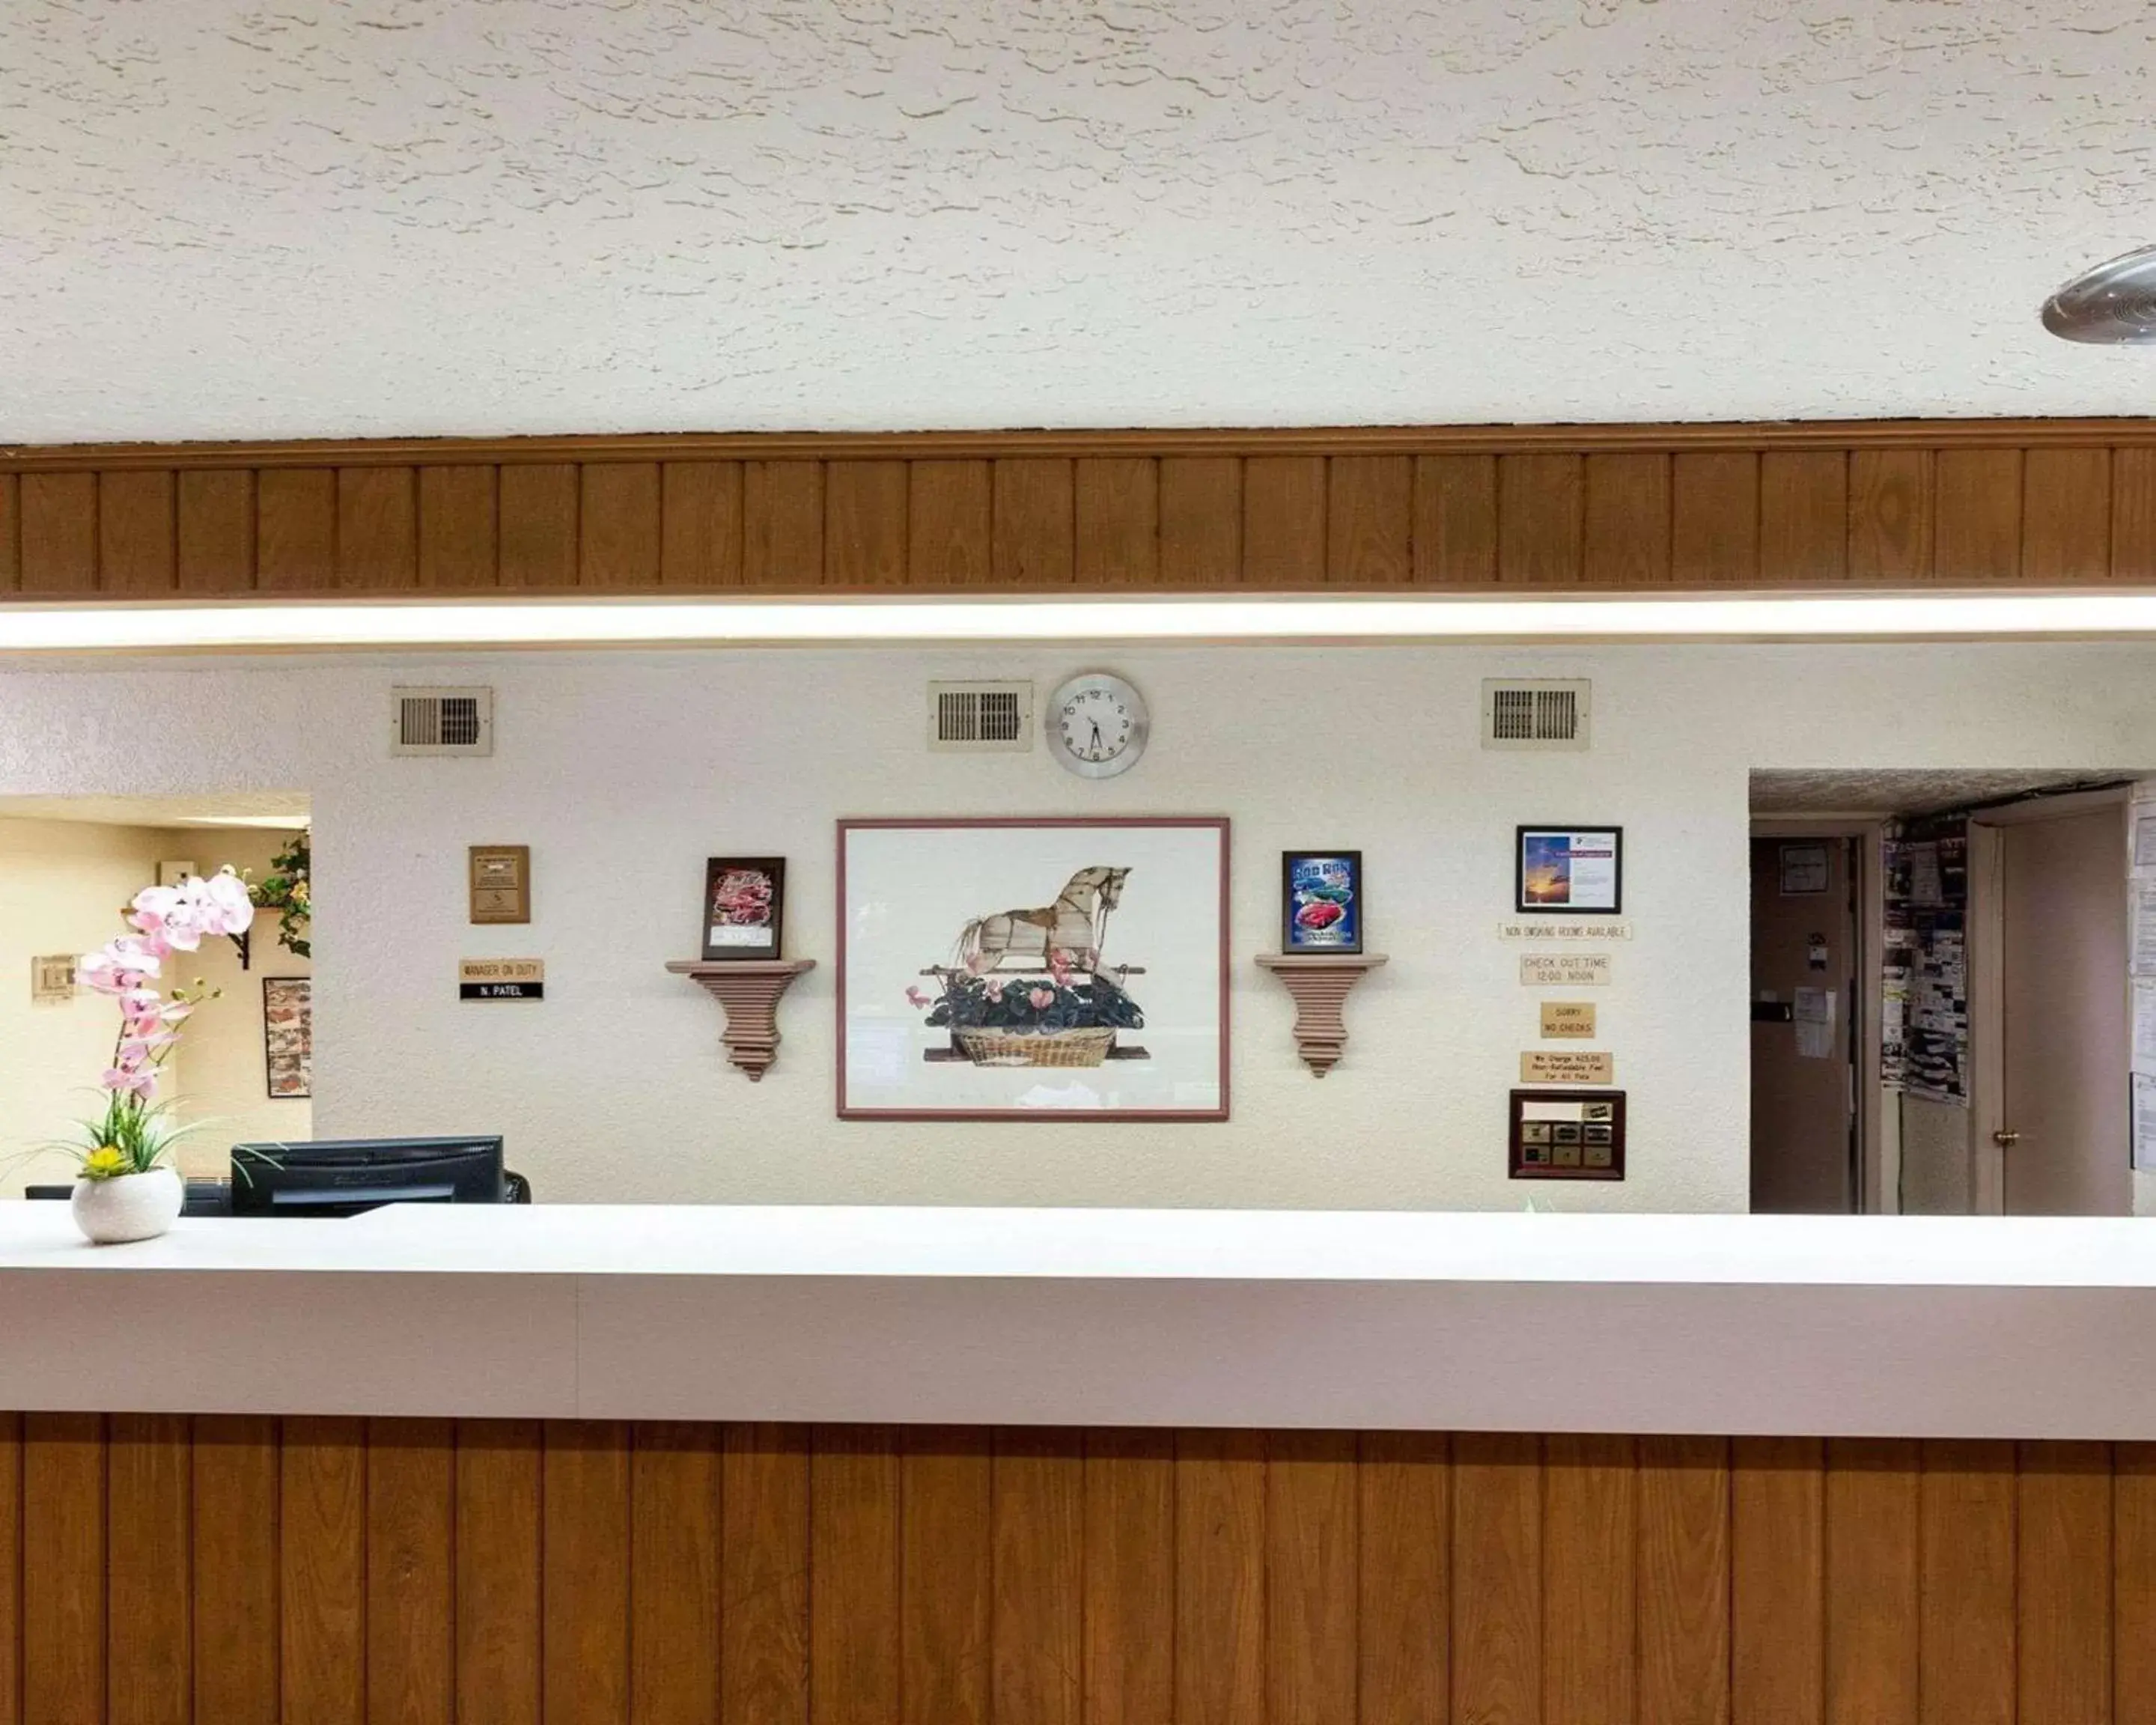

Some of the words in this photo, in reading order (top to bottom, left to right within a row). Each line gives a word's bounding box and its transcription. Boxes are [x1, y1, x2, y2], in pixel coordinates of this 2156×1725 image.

[1076, 695, 1085, 704] 11
[1090, 690, 1101, 700] 12
[1108, 694, 1113, 702] 1
[1064, 706, 1076, 716] 10
[1118, 705, 1124, 714] 2
[1062, 722, 1068, 731] 9
[1122, 719, 1129, 728] 3
[1119, 735, 1125, 743] 4
[1078, 747, 1085, 758] 7
[1093, 752, 1100, 761] 6
[1524, 958, 1554, 968] CHECK
[1560, 958, 1578, 967] OUT
[1583, 958, 1608, 968] TIME
[464, 964, 499, 976] MANAGER
[502, 964, 514, 976] ON
[517, 964, 537, 975] DUTY
[1567, 971, 1595, 982] NOON
[480, 986, 492, 996] N.
[493, 985, 523, 996] PATEL
[1556, 1008, 1582, 1017] SORRY
[1544, 1023, 1556, 1032] NO
[1559, 1023, 1592, 1032] CHECKS
